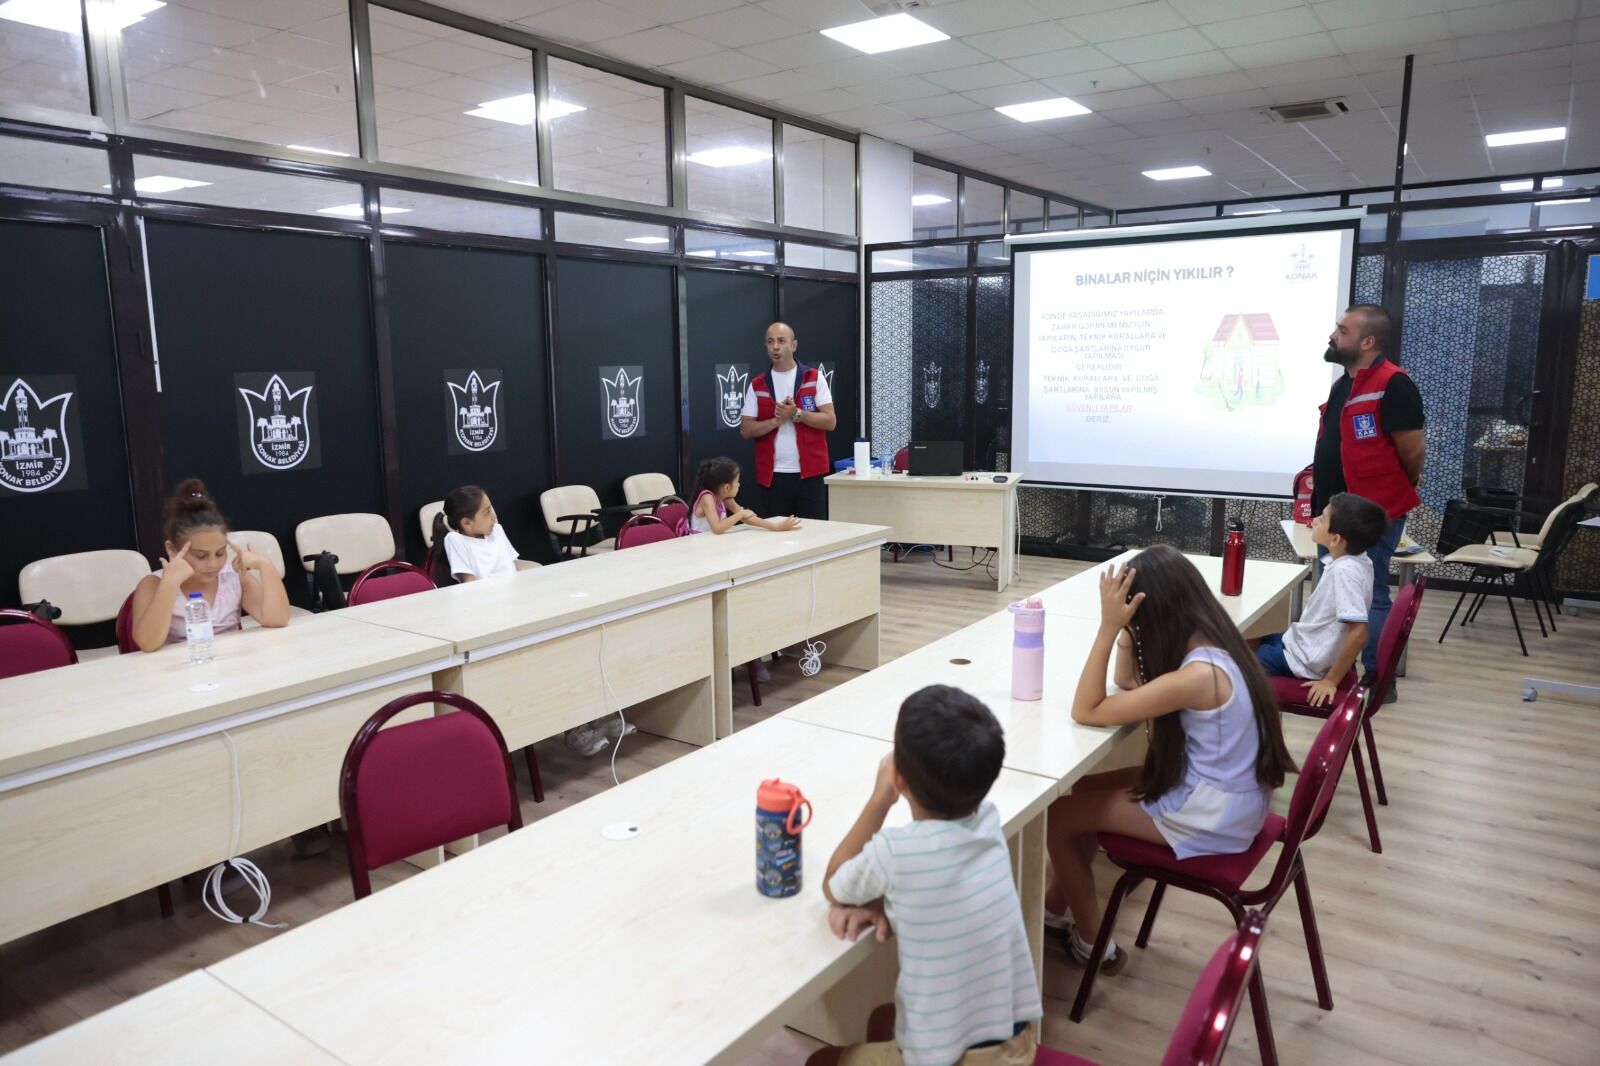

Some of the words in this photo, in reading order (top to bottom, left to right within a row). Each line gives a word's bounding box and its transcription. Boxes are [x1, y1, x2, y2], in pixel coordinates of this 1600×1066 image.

[1075, 272, 1131, 287] BİNALAR
[1133, 267, 1171, 286] NİÇİN
[1173, 266, 1223, 281] YIKILIR
[1226, 265, 1235, 278] ?
[1285, 272, 1318, 281] KONAK
[1157, 330, 1168, 340] VE
[271, 442, 292, 451] İZMİR
[257, 443, 277, 464] KONAK
[15, 460, 44, 470] İZMİR
[21, 469, 41, 478] 1984
[25, 457, 63, 486] BELEDİYESİ
